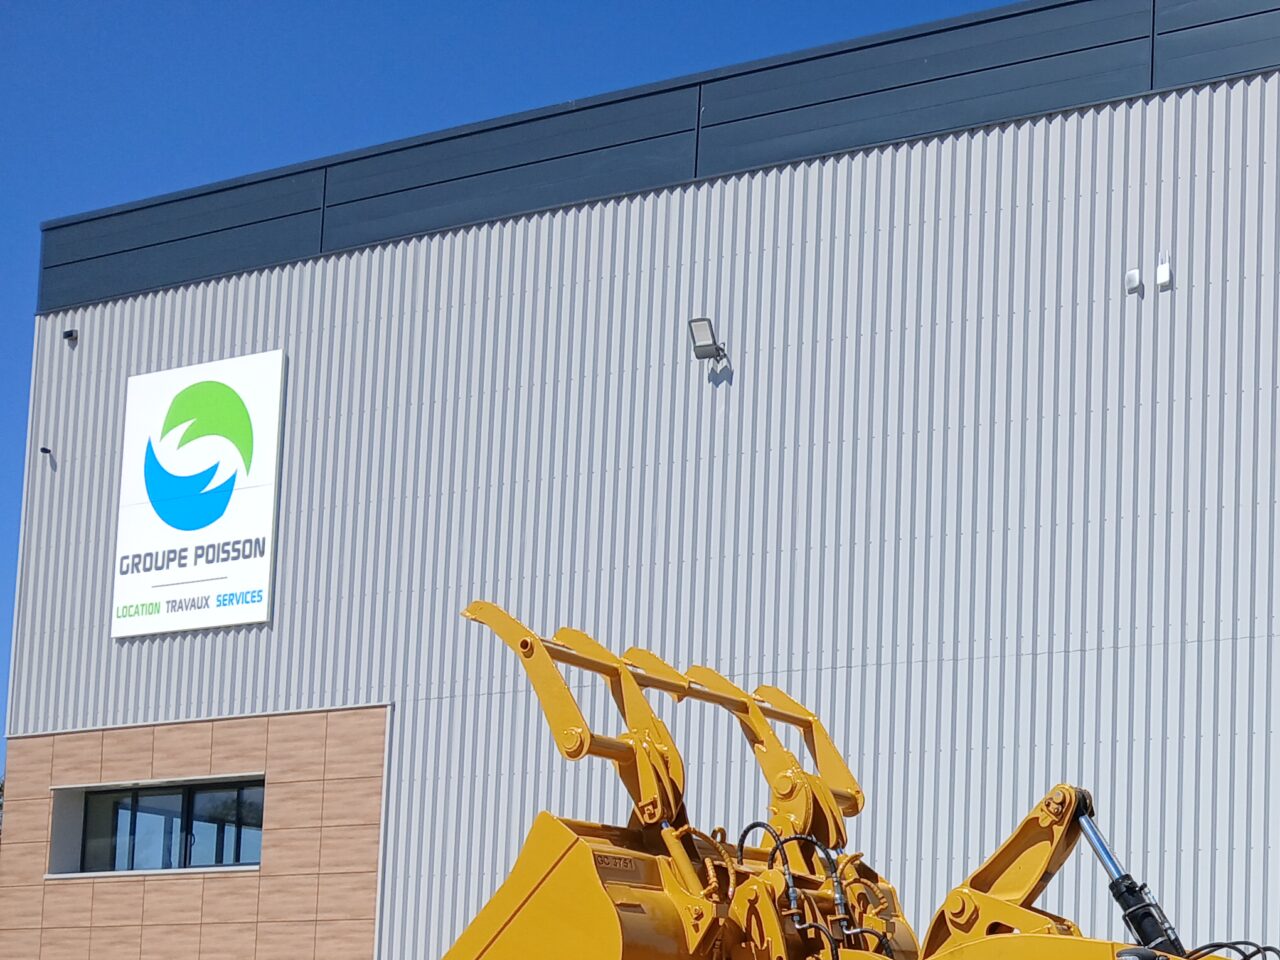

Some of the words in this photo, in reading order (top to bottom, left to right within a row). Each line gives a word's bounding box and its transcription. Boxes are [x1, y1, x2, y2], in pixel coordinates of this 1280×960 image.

[119, 547, 188, 575] GROUPE
[194, 537, 266, 566] POISSON
[116, 602, 161, 619] LOCATION
[166, 595, 210, 613] TRAVAUX
[216, 589, 263, 607] SERVICES
